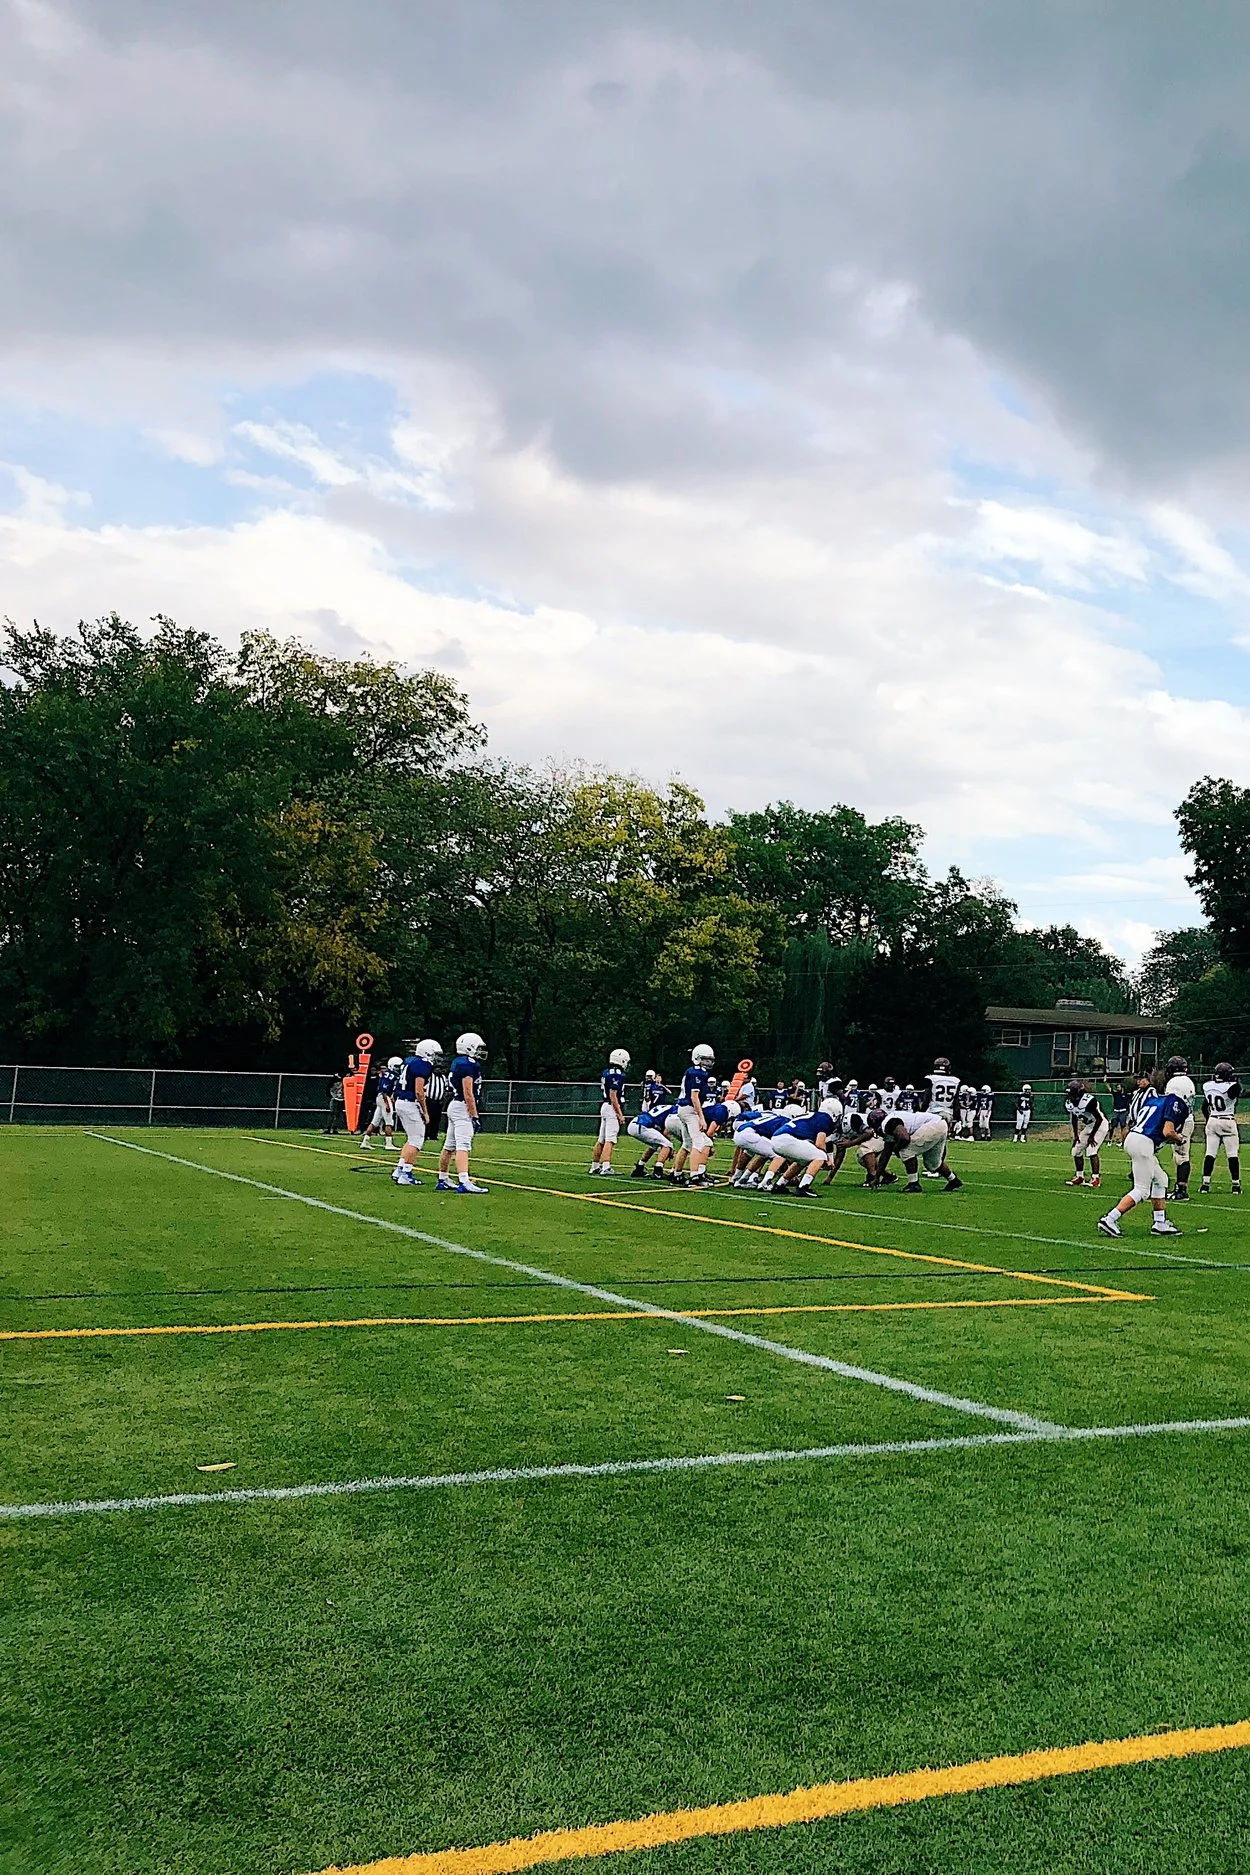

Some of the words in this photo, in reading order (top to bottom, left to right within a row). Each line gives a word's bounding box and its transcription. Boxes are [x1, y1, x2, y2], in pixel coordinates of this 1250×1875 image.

[936, 1085, 956, 1102] 25
[775, 1099, 782, 1108] 6
[1206, 1094, 1226, 1112] 10
